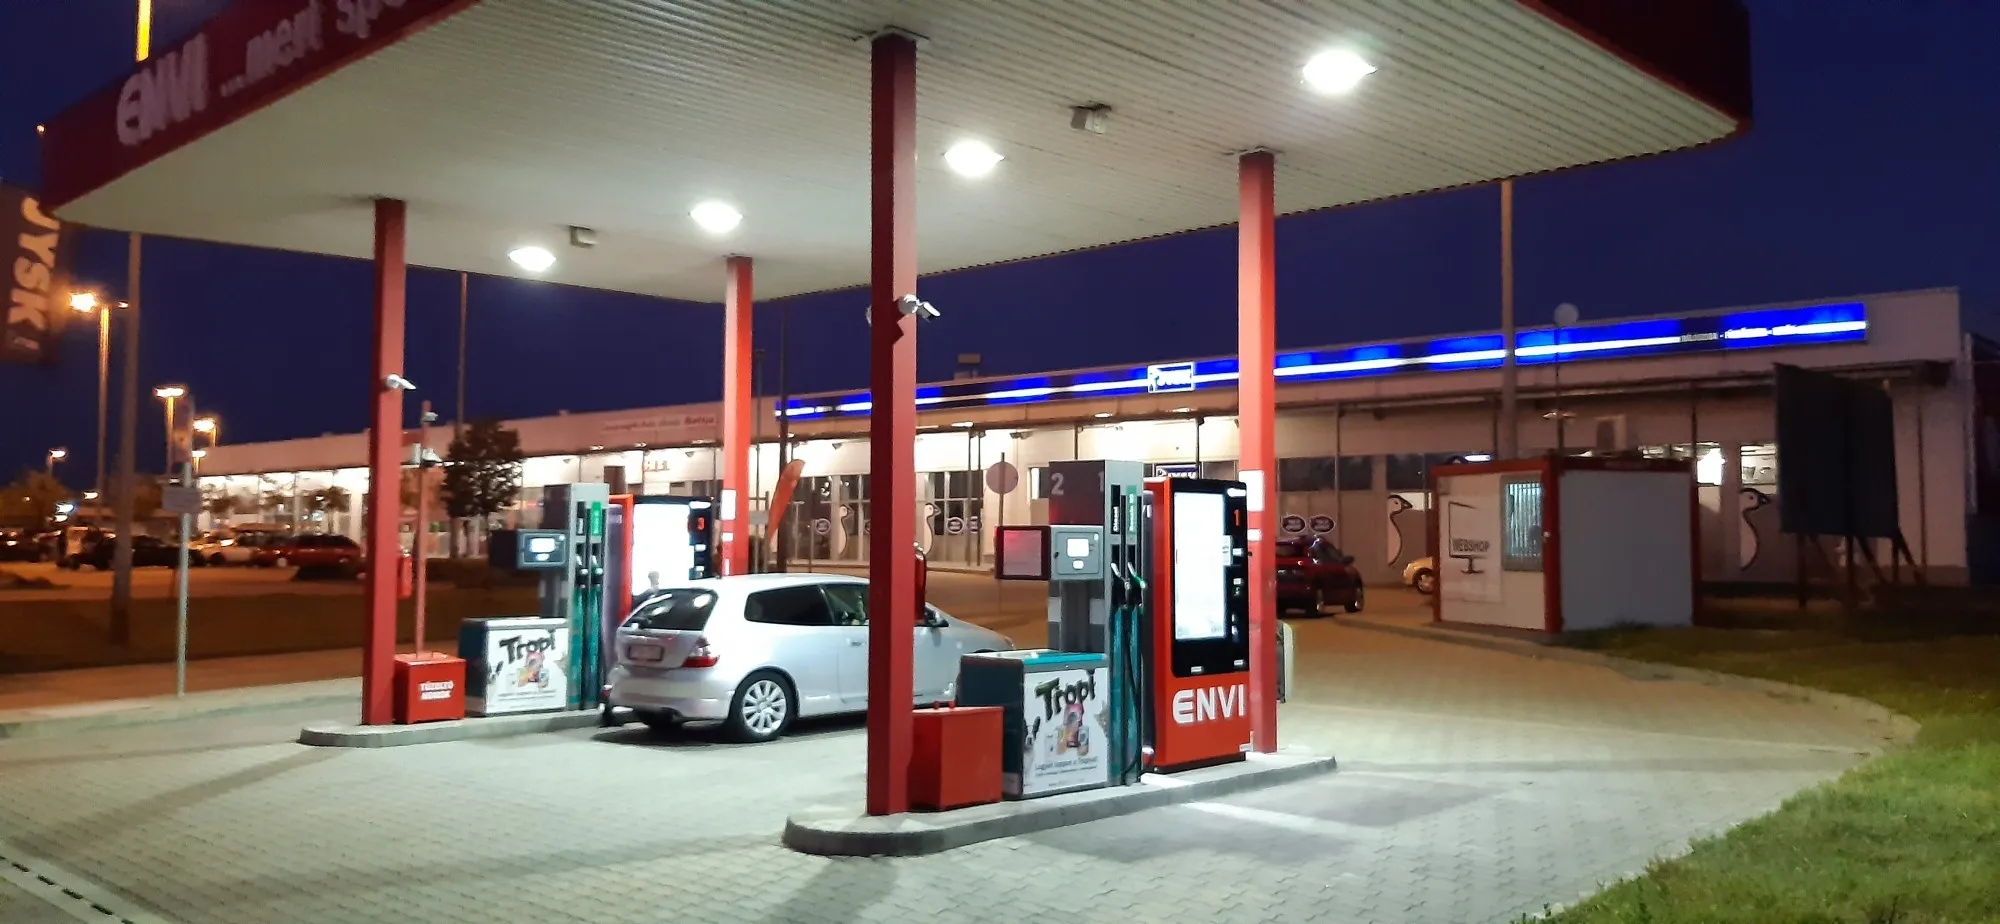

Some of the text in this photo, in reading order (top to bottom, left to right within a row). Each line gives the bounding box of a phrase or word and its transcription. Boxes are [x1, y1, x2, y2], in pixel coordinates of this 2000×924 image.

[116, 32, 209, 146] ENVI
[335, 0, 405, 39] sp
[7, 197, 60, 331] JYSK
[1051, 472, 1064, 495] 2
[1233, 508, 1240, 527] 1
[1451, 539, 1490, 553] WEBSHOP
[499, 629, 556, 665] Tropi
[1034, 669, 1096, 723] Tropi
[1172, 683, 1246, 725] ENVI
